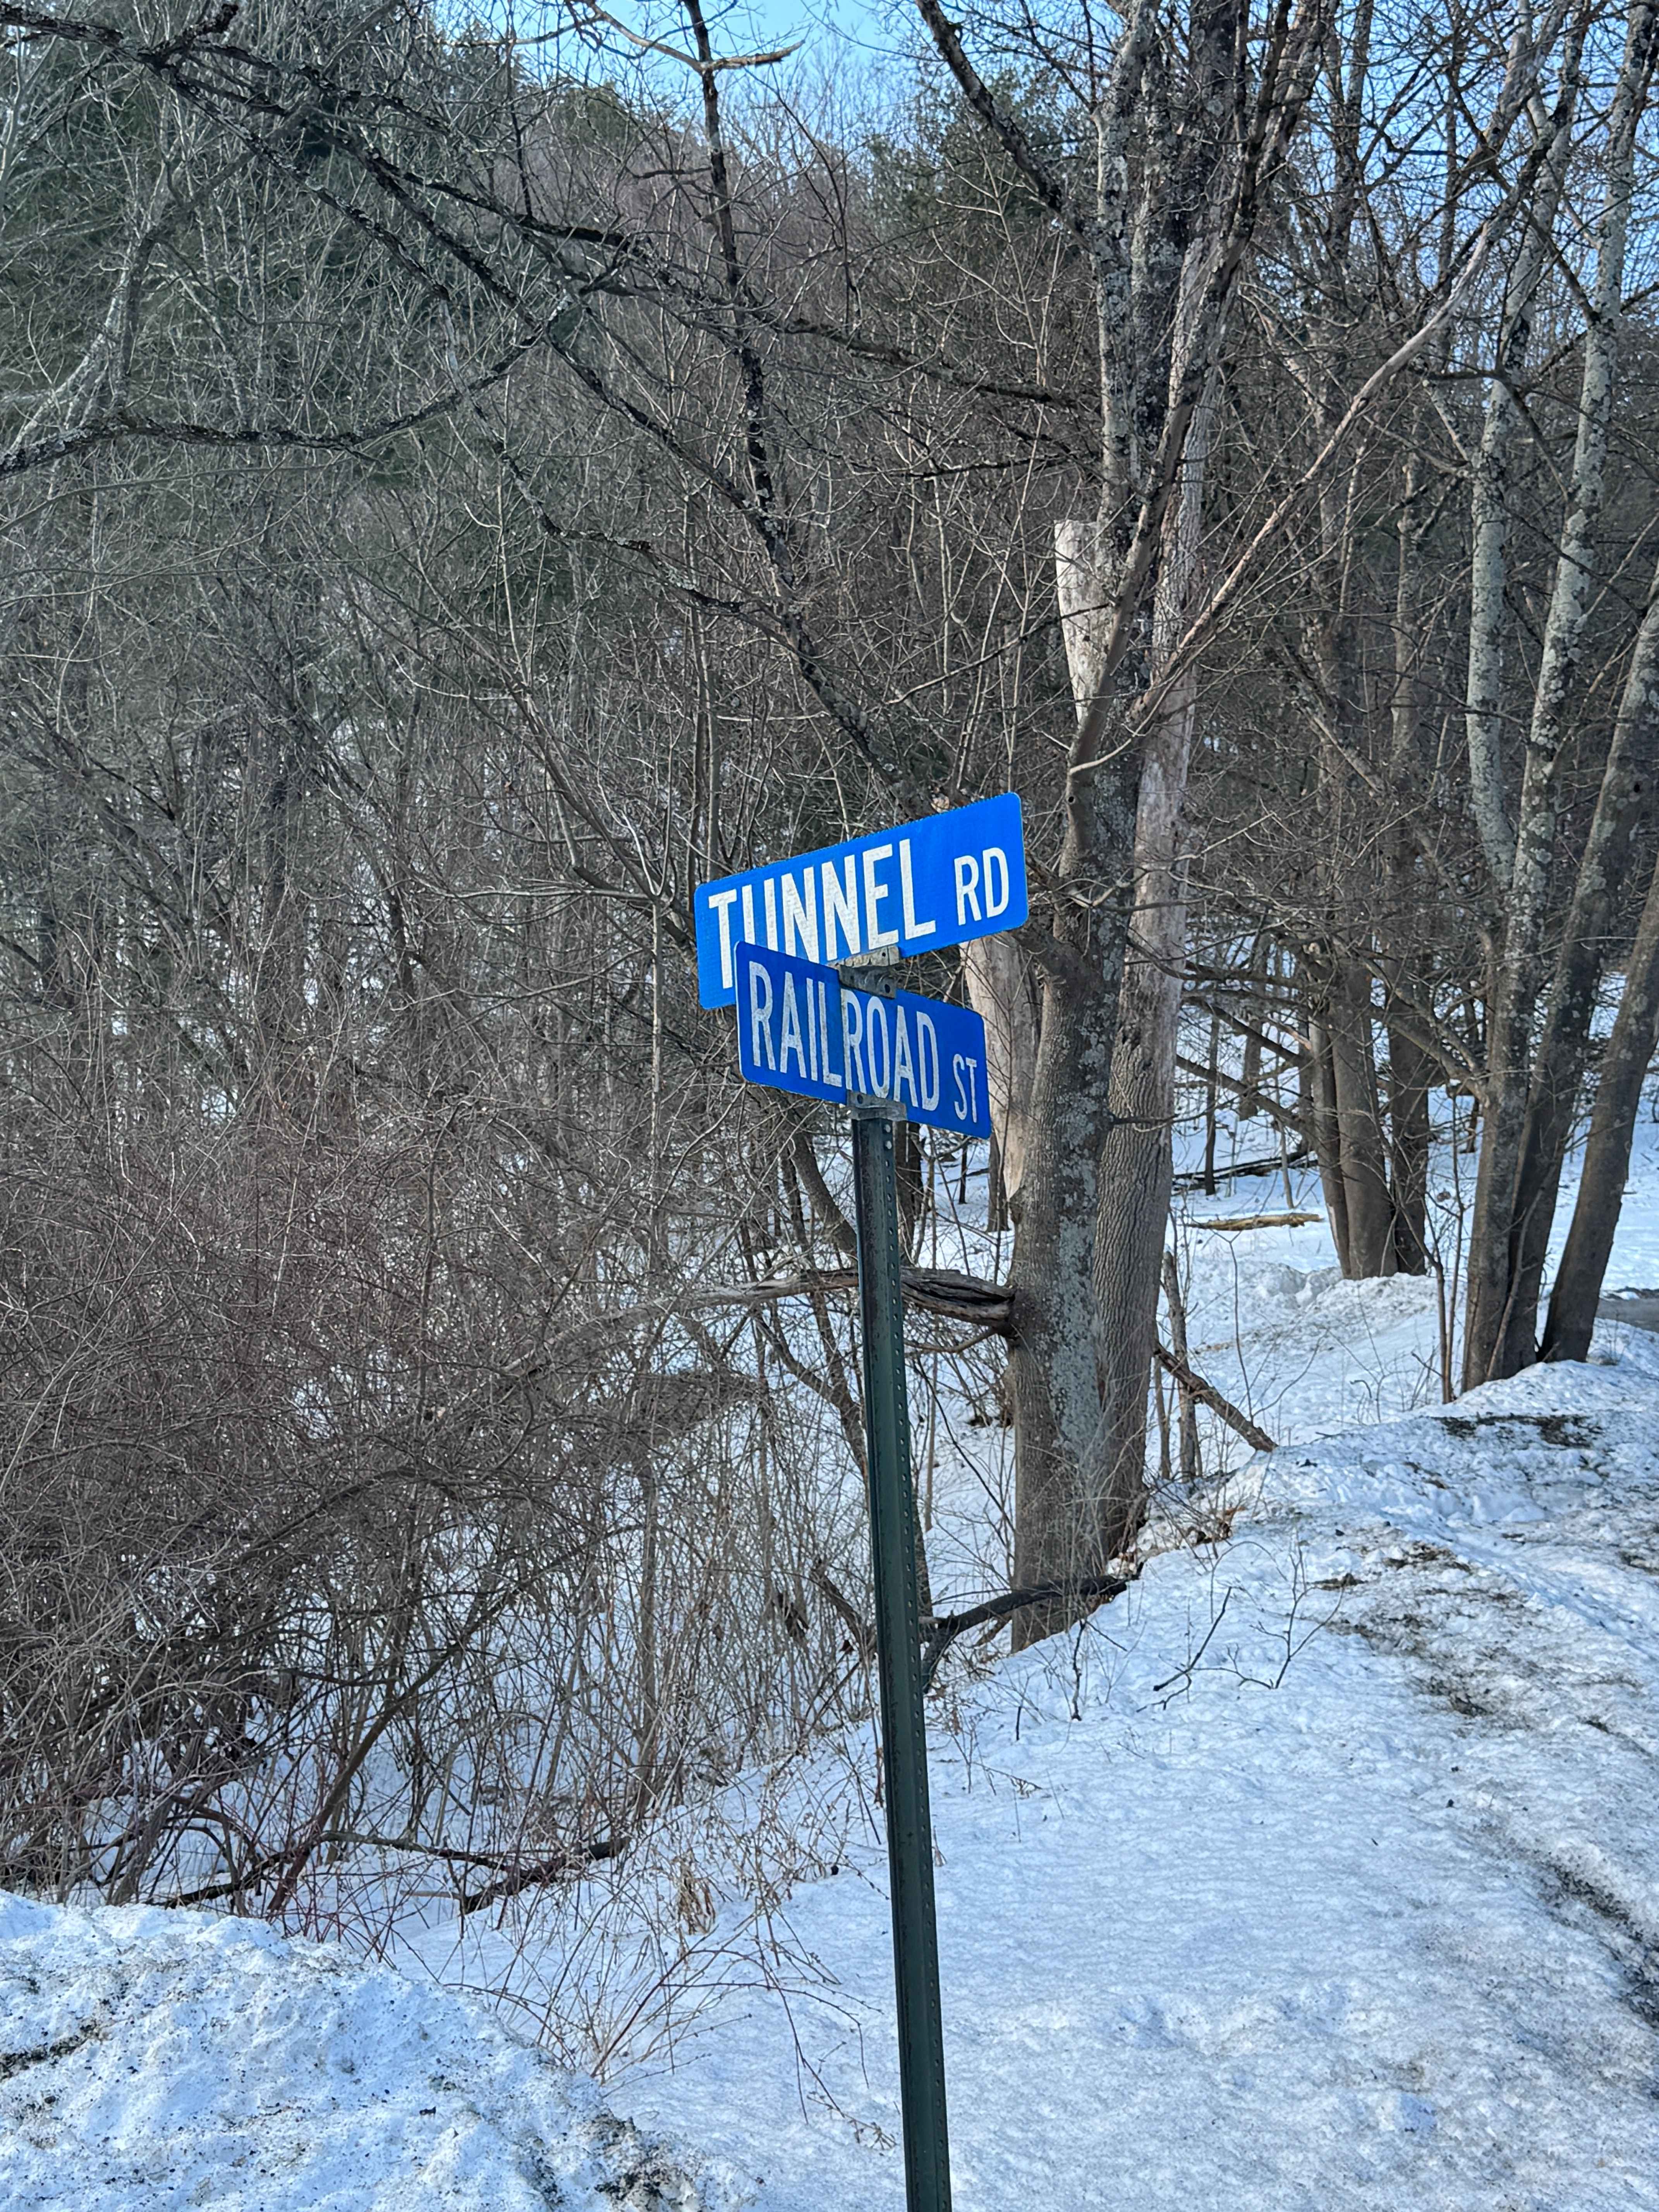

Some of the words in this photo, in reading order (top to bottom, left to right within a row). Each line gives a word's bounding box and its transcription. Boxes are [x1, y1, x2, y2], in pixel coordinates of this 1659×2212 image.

[709, 839, 936, 989] TUNNEL
[954, 847, 1009, 926] RD
[749, 961, 939, 1111] RAILROAD
[952, 1053, 977, 1123] ST
